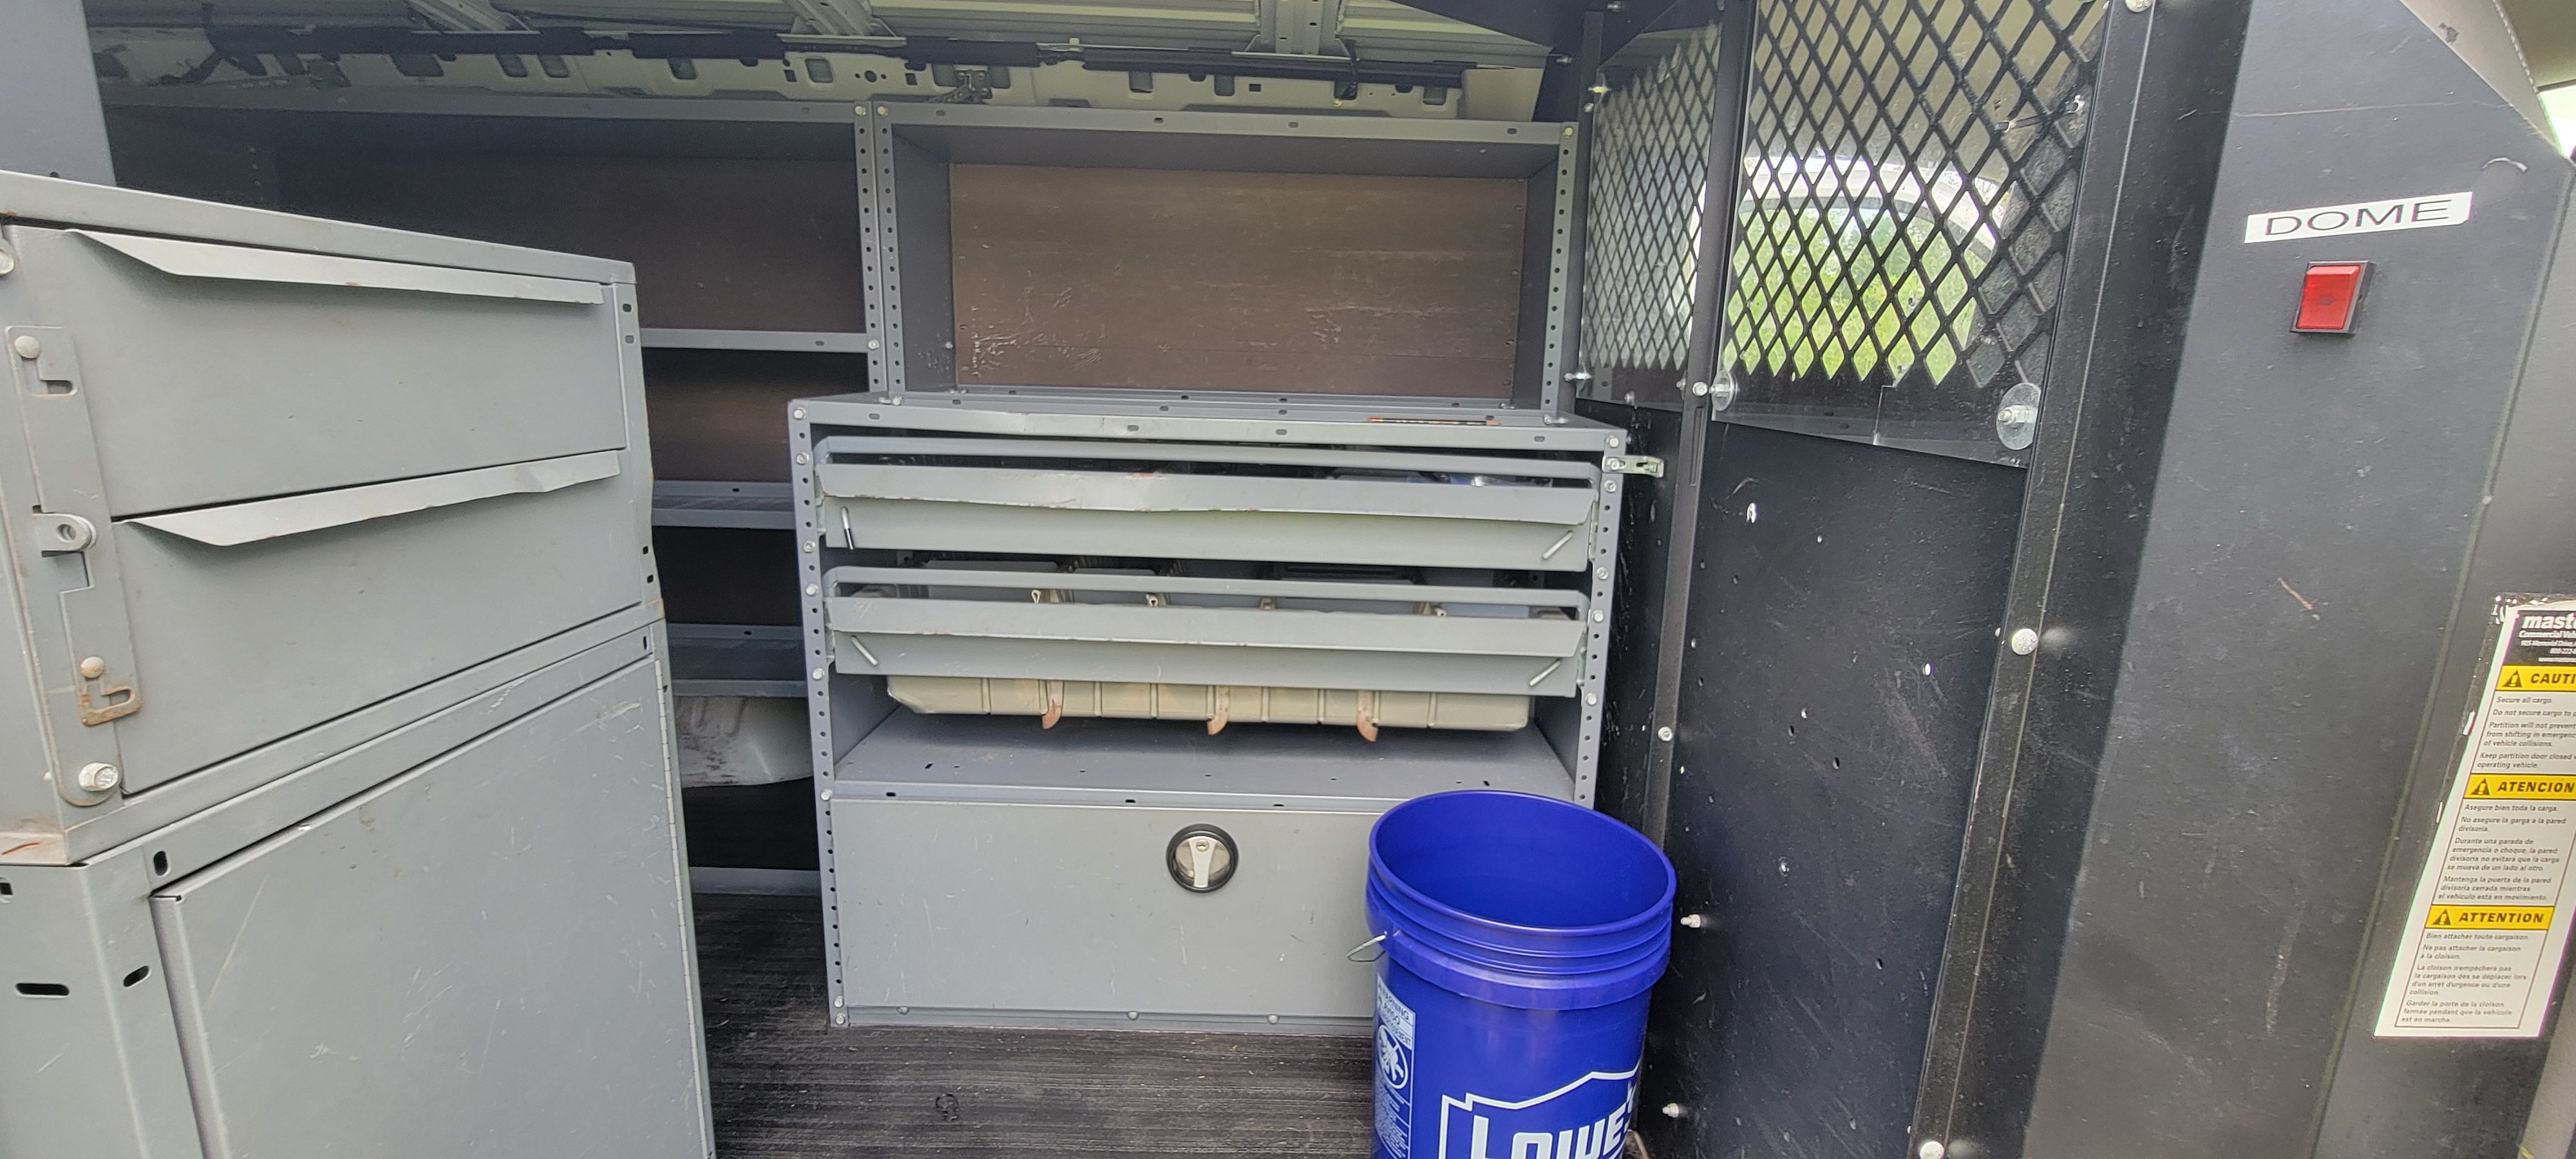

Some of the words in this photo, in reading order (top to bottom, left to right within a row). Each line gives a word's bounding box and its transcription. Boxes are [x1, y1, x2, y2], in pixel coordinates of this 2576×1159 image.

[2266, 199, 2452, 236] DOME
[2522, 612, 2576, 629] mast
[2458, 912, 2544, 923] ATTENTION
